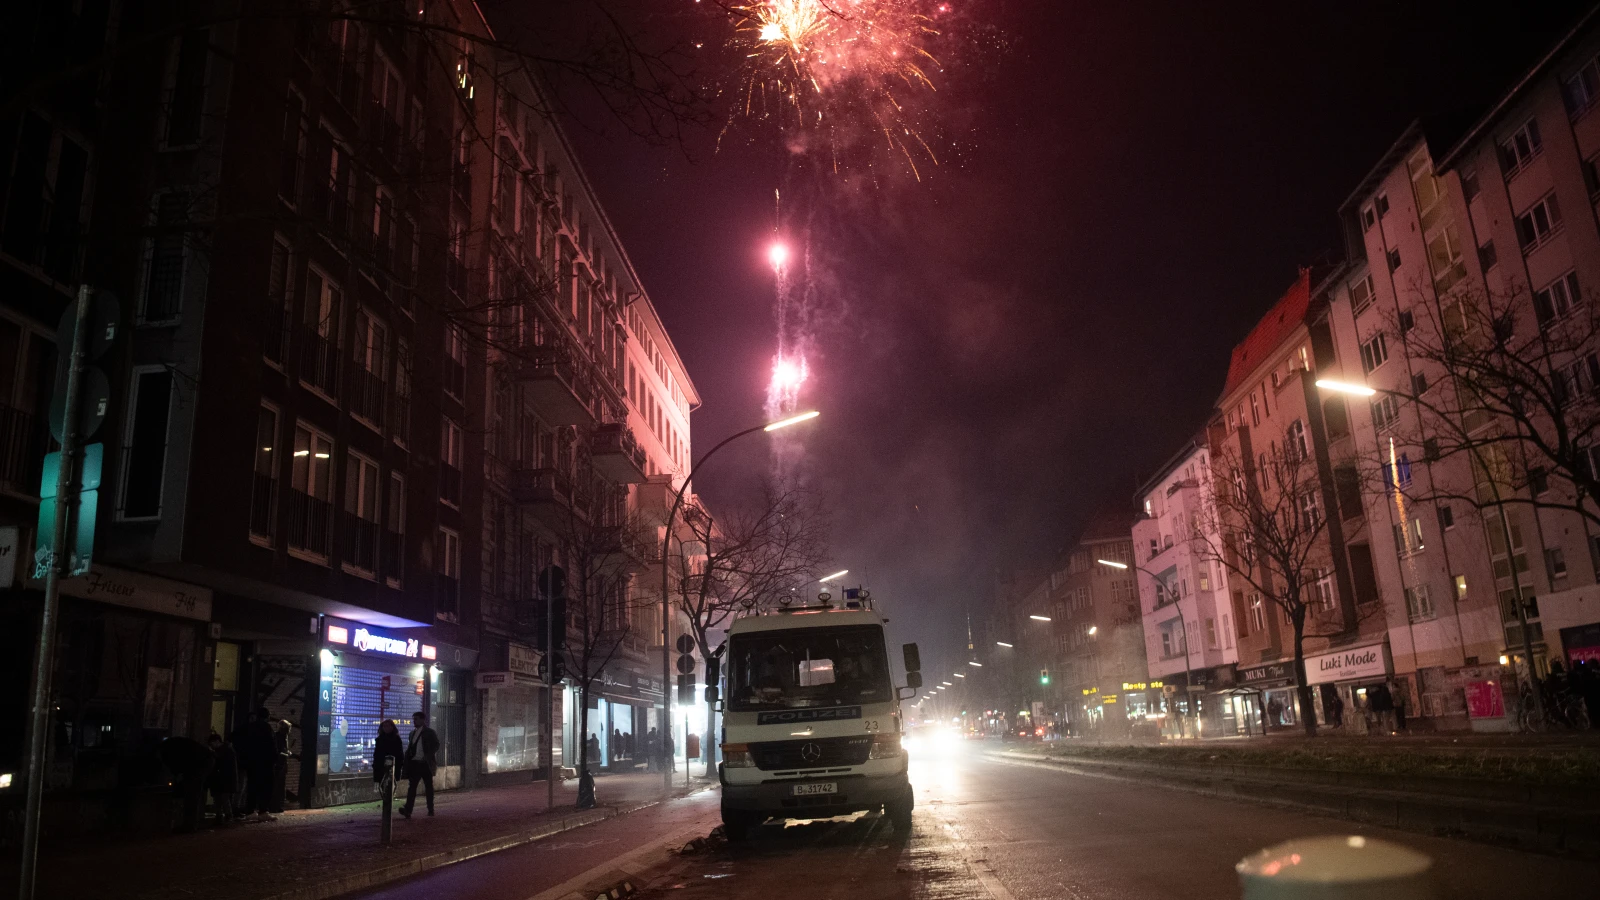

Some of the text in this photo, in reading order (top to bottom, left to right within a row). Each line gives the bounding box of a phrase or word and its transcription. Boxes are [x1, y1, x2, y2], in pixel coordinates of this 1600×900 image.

[86, 571, 135, 597] Friseur
[407, 638, 419, 658] 24
[1320, 651, 1377, 671] Luki Mode
[1245, 668, 1266, 681] MUKI
[762, 708, 858, 722] POLIZEI
[864, 720, 879, 730] 23
[797, 783, 833, 794] B 31742
